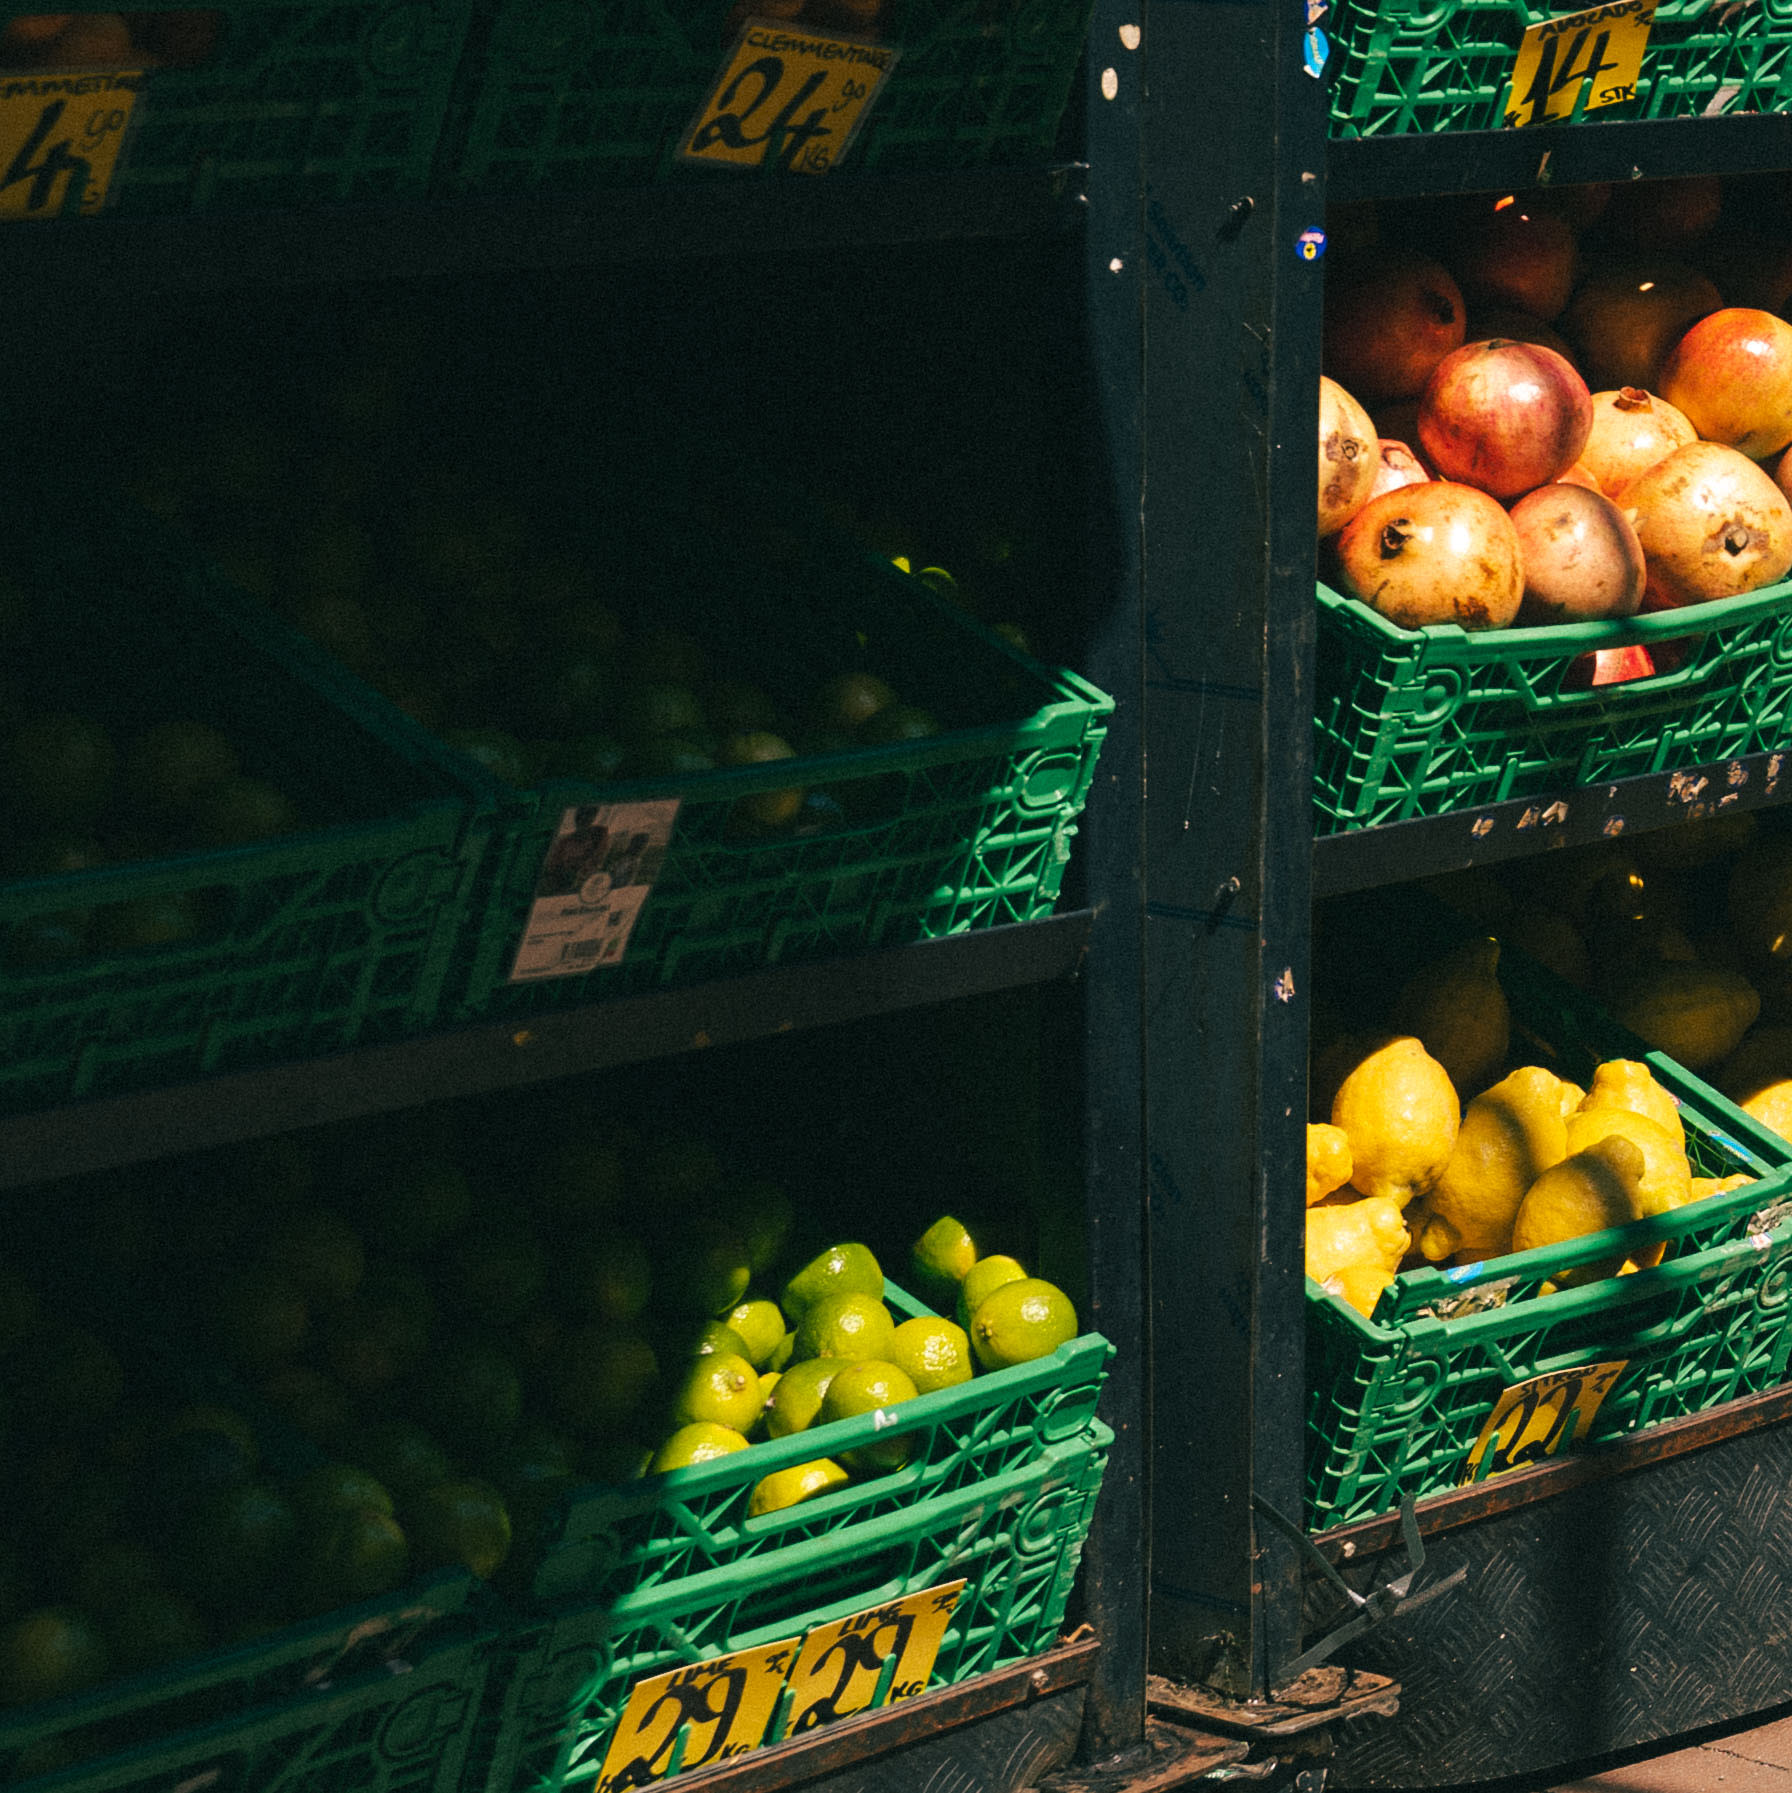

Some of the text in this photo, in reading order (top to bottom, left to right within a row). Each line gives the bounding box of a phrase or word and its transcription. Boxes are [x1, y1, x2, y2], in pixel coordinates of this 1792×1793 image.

[1539, 0, 1644, 41] AVOCADO
[1519, 26, 1619, 125] 14
[1599, 83, 1636, 104] STK
[691, 56, 833, 170] 24
[838, 1601, 904, 1636] LIME
[665, 1655, 736, 1691] LIME
[792, 1613, 917, 1735] 29
[612, 1666, 748, 1788] 29
